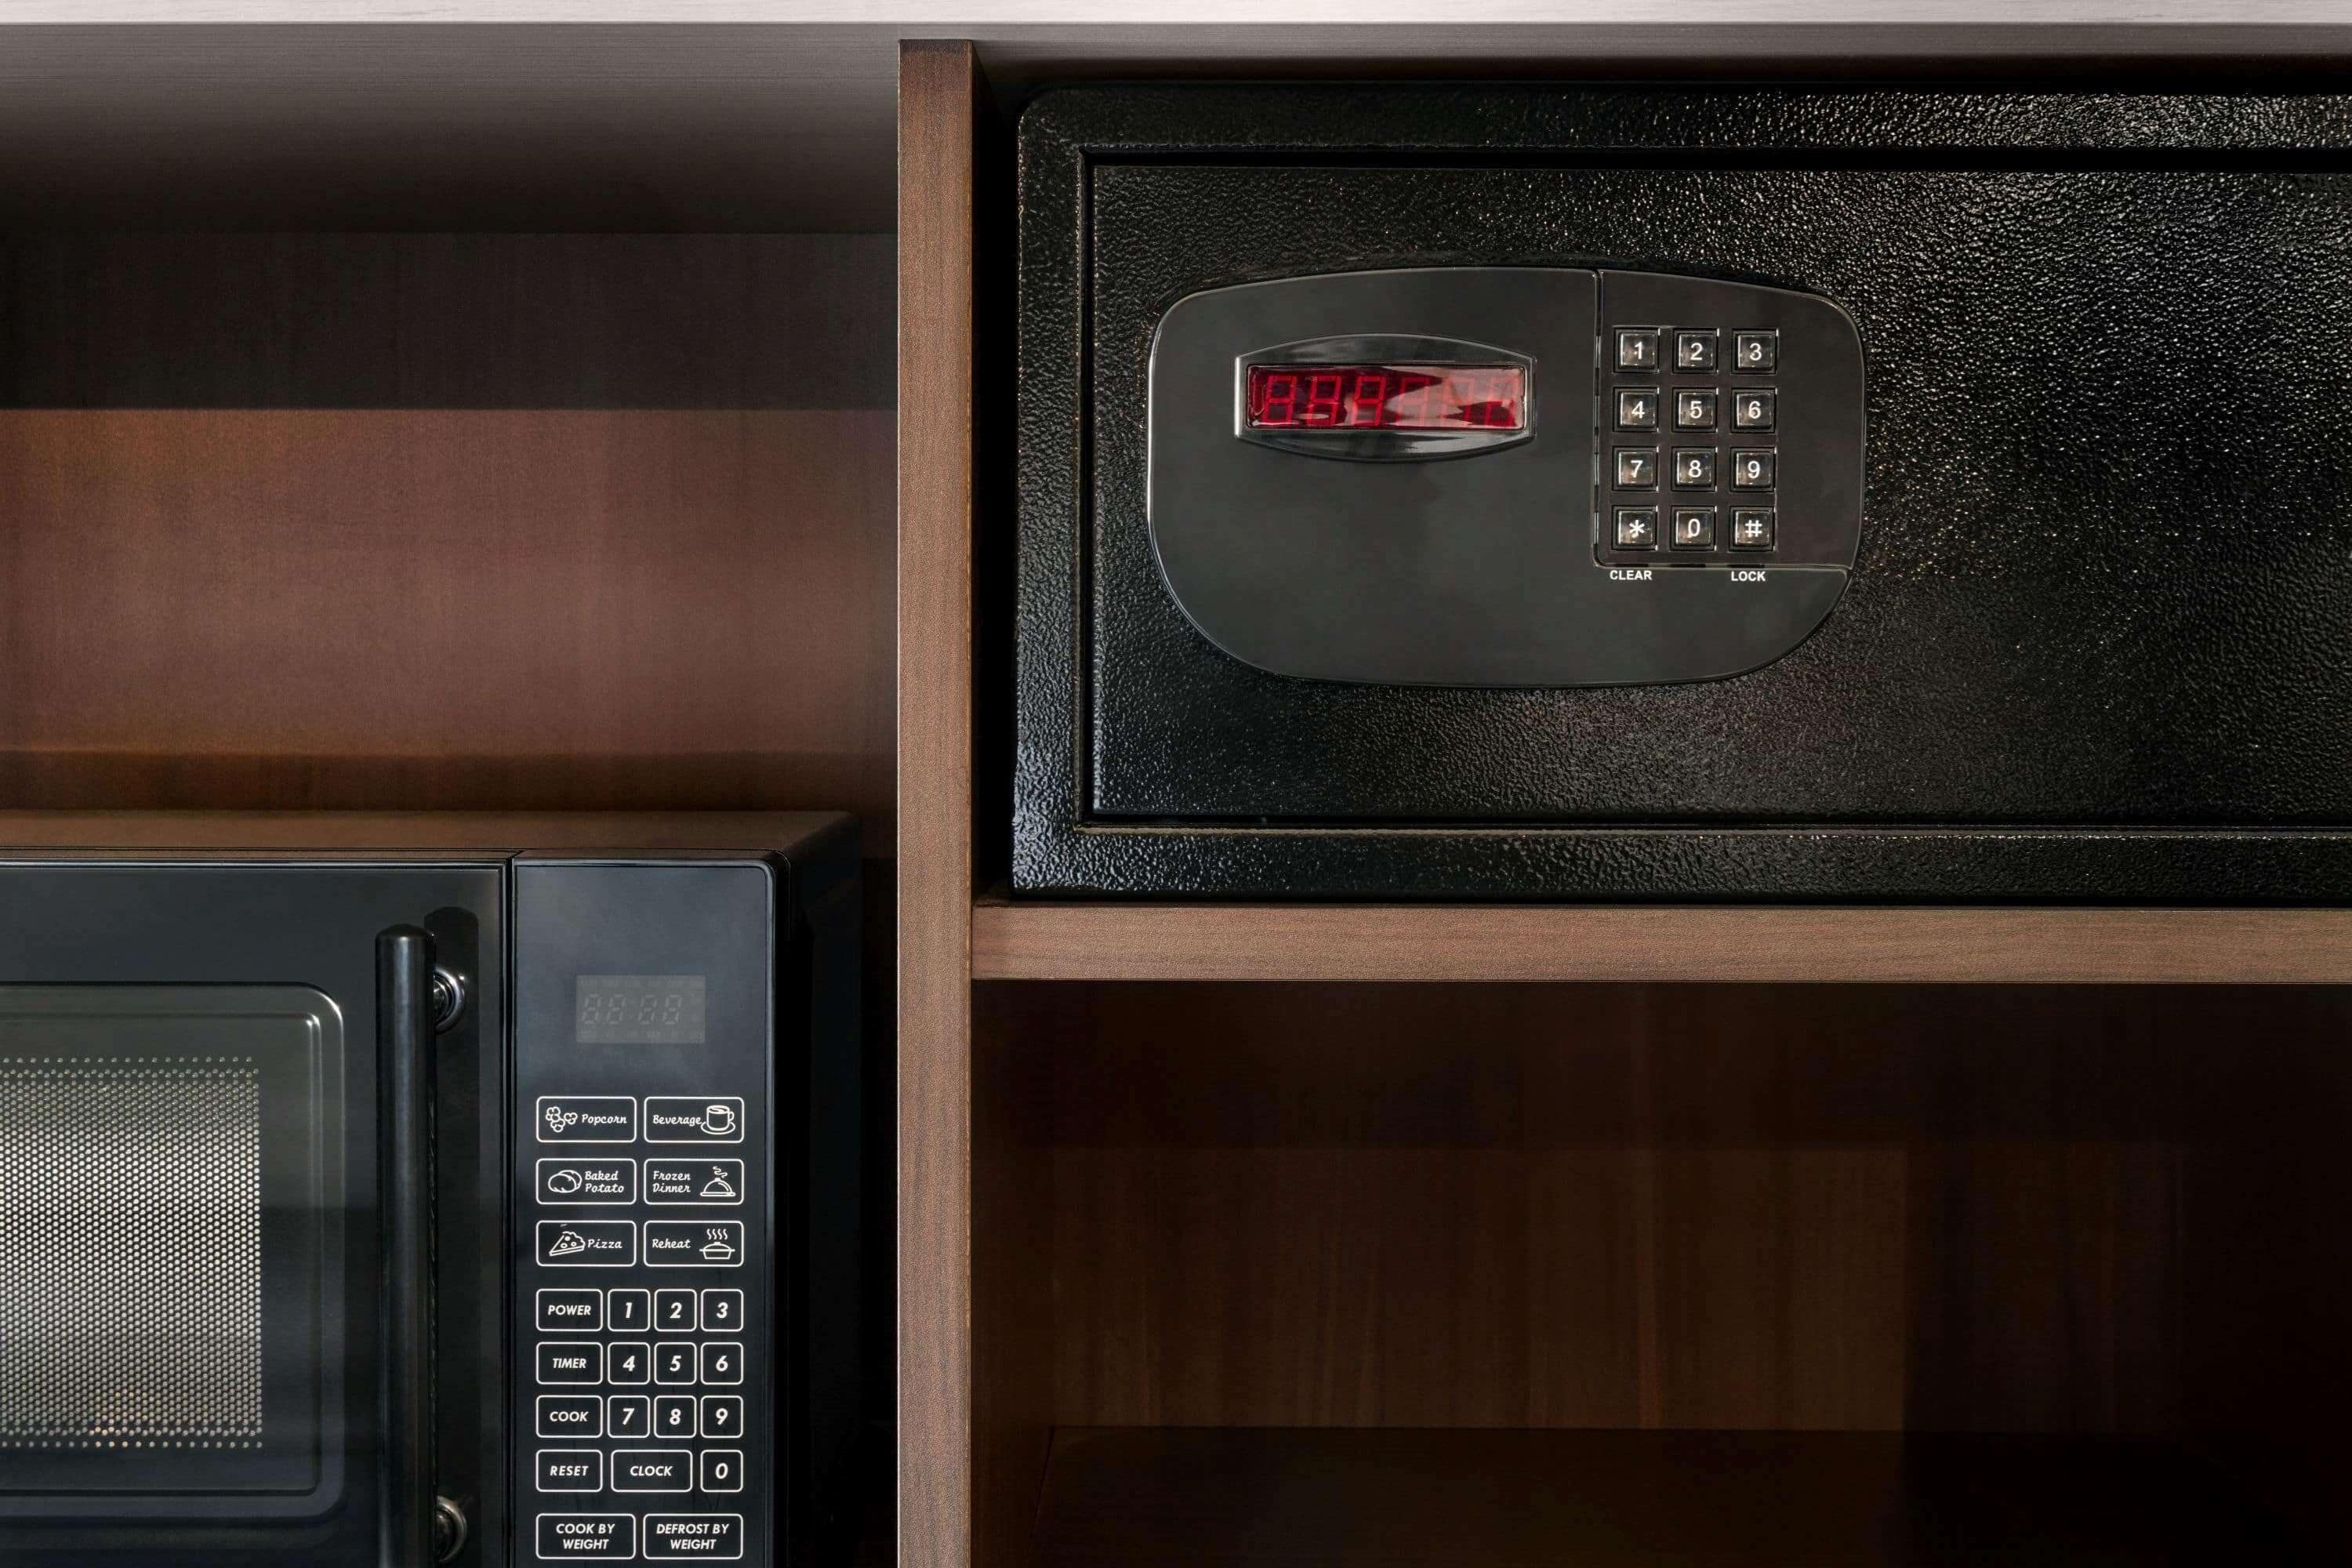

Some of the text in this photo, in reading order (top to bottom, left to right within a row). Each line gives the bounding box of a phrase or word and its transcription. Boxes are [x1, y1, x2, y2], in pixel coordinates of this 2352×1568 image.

[1634, 342, 1762, 361] 1 2 3
[1632, 401, 1761, 419] 4 5 6
[1631, 459, 1760, 479] 7 8 9
[1687, 518, 1700, 538] 0
[1745, 520, 1762, 538] #
[1610, 570, 1652, 580] CLEAR
[1731, 571, 1766, 582] LOCK
[581, 1113, 628, 1126] Popcorn
[652, 1114, 702, 1127] Beverage
[584, 1170, 619, 1181] Baked
[653, 1170, 691, 1181] Frozen
[585, 1182, 625, 1193] Potato
[652, 1182, 691, 1193] Dinner
[587, 1238, 623, 1249] Pizza
[652, 1238, 691, 1249] Reheat
[547, 1305, 592, 1316] POWER
[625, 1301, 728, 1319] 1 2 3
[552, 1357, 587, 1369] TIMER
[622, 1355, 728, 1372] 4 5 6
[549, 1410, 589, 1422] COOK
[622, 1407, 728, 1425] 7 8 9
[550, 1465, 589, 1476] RESET
[630, 1465, 673, 1477] CLOCK
[715, 1462, 728, 1479] 0
[556, 1523, 615, 1534] COOK BY
[656, 1523, 730, 1534] DEFROST BY
[562, 1538, 610, 1550] WEIGHT
[670, 1538, 717, 1550] WEIGHT
